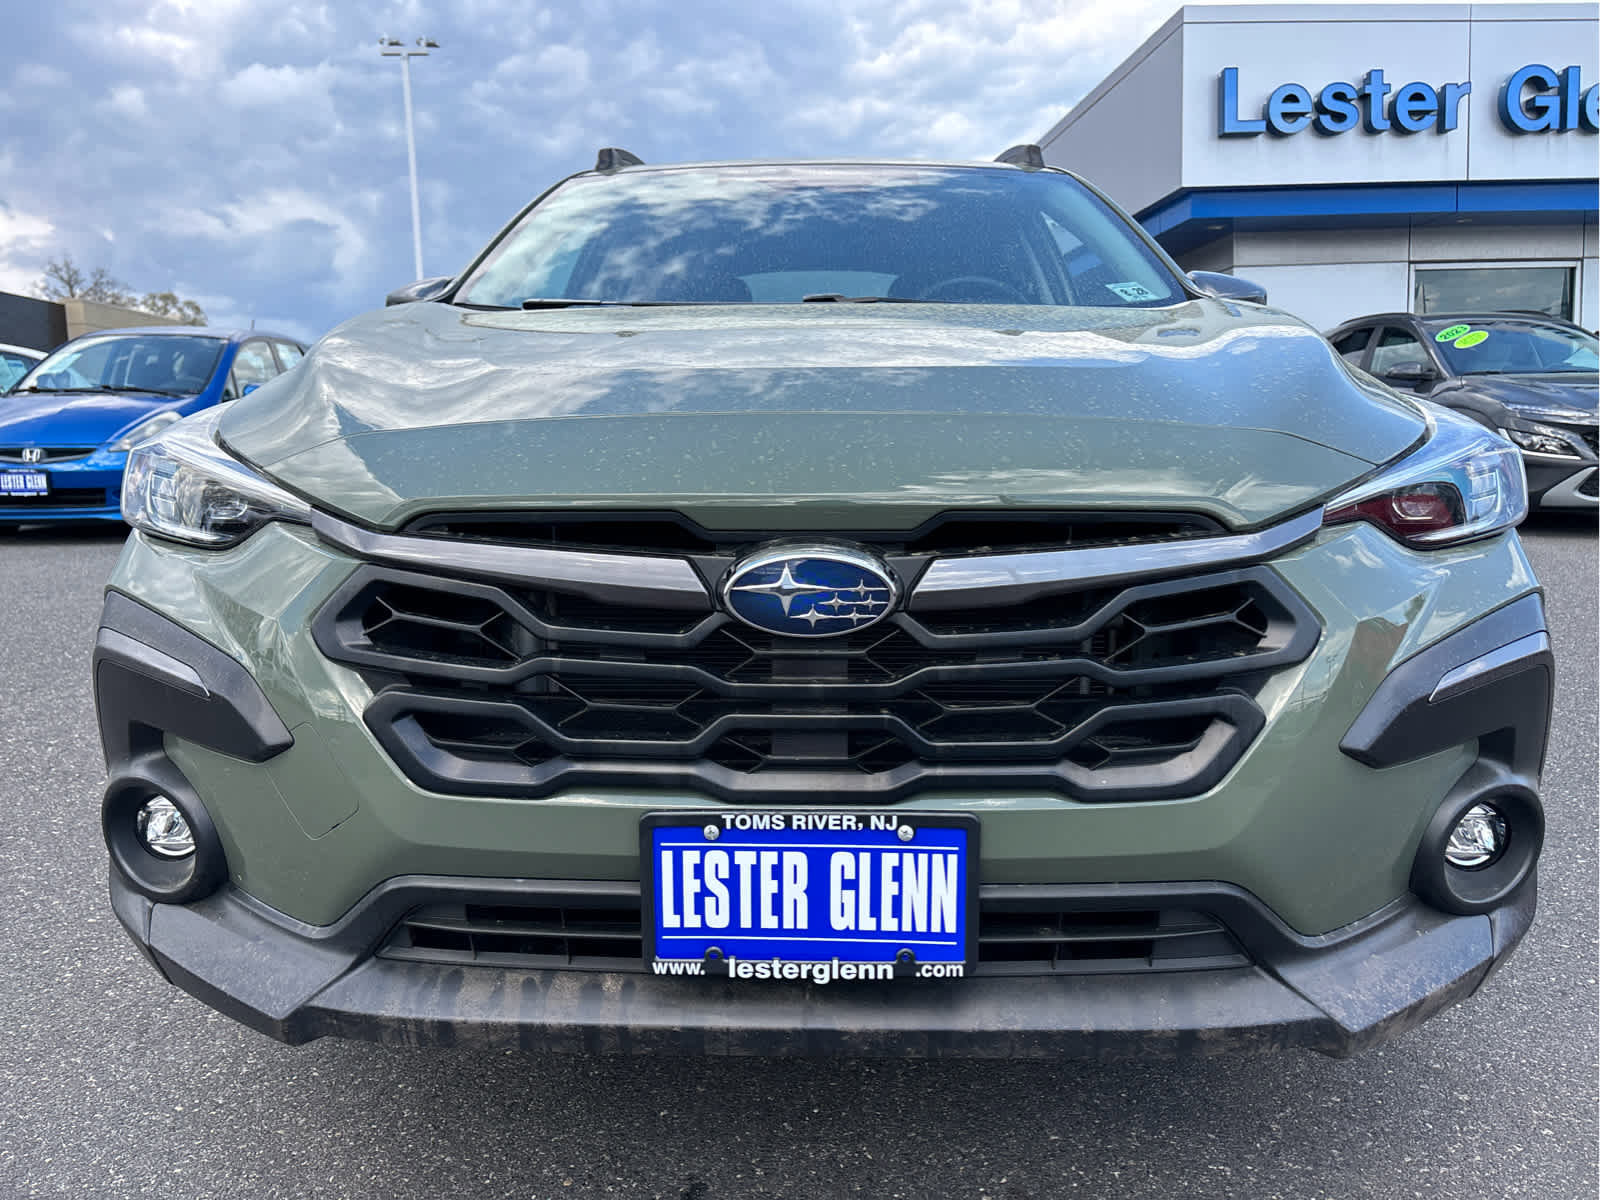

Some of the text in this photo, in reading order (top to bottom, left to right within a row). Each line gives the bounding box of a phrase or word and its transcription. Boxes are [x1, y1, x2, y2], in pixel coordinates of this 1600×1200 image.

[1218, 66, 1472, 138] Lester
[0, 473, 48, 489] LESTER GLENN
[721, 814, 898, 832] TOMS RIVER, NJ
[660, 849, 959, 934] LESTER GLENN
[652, 955, 965, 985] www. lesterglenn .com
